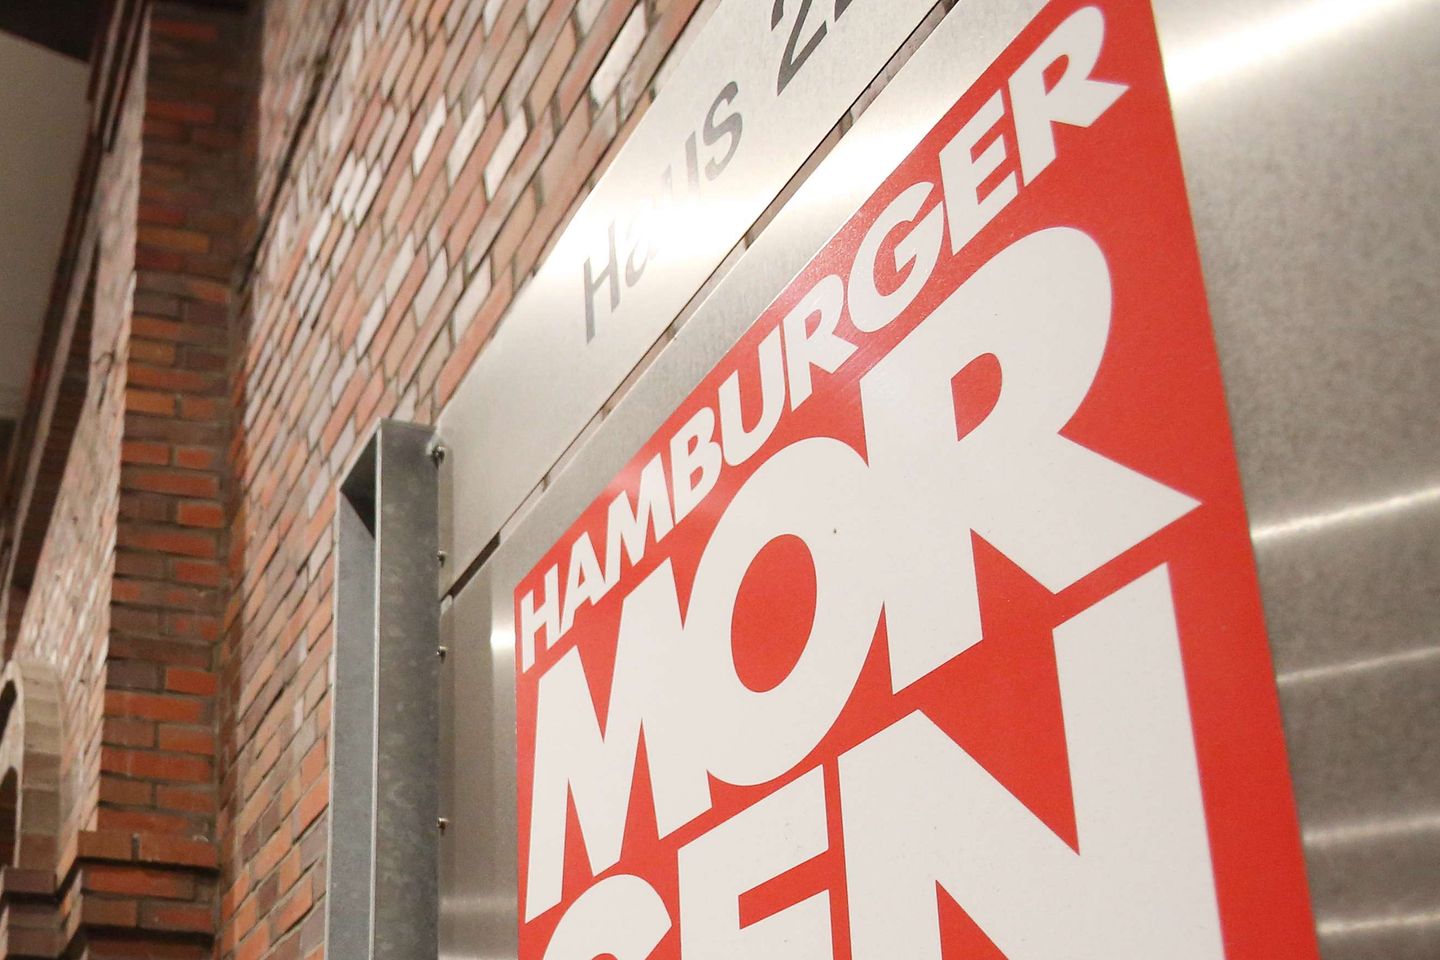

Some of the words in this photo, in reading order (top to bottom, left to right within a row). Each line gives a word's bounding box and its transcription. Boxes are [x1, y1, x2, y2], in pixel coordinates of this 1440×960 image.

[521, 6, 1130, 674] HAMBURGER
[771, 0, 853, 97] 2
[525, 226, 1202, 924] MOR
